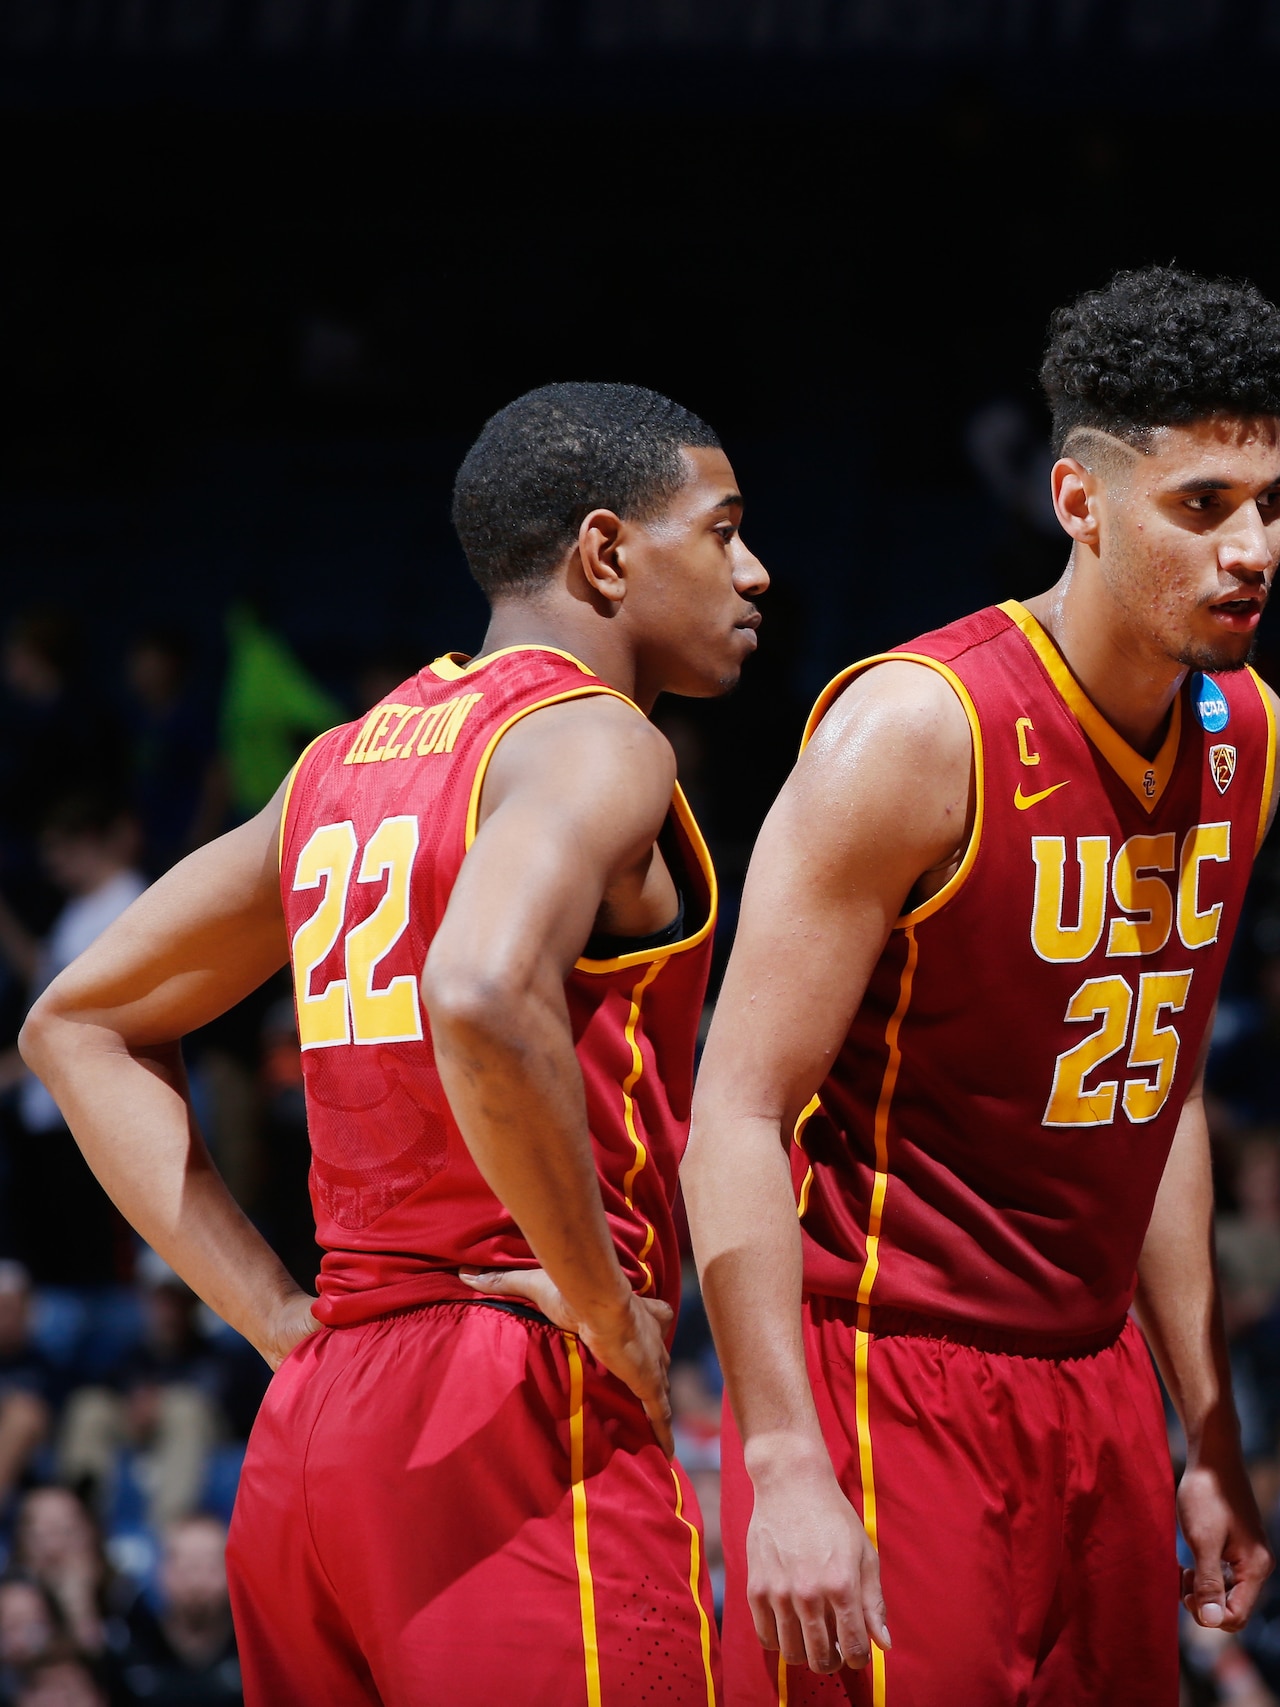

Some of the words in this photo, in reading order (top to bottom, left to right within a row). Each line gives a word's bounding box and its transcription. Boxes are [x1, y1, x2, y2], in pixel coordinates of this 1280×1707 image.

[1015, 717, 1041, 766] C
[1196, 700, 1227, 717] NCAA
[1216, 765, 1229, 783] 12
[293, 815, 423, 1052] 22
[1031, 821, 1231, 963] USC
[1041, 968, 1194, 1127] 25
